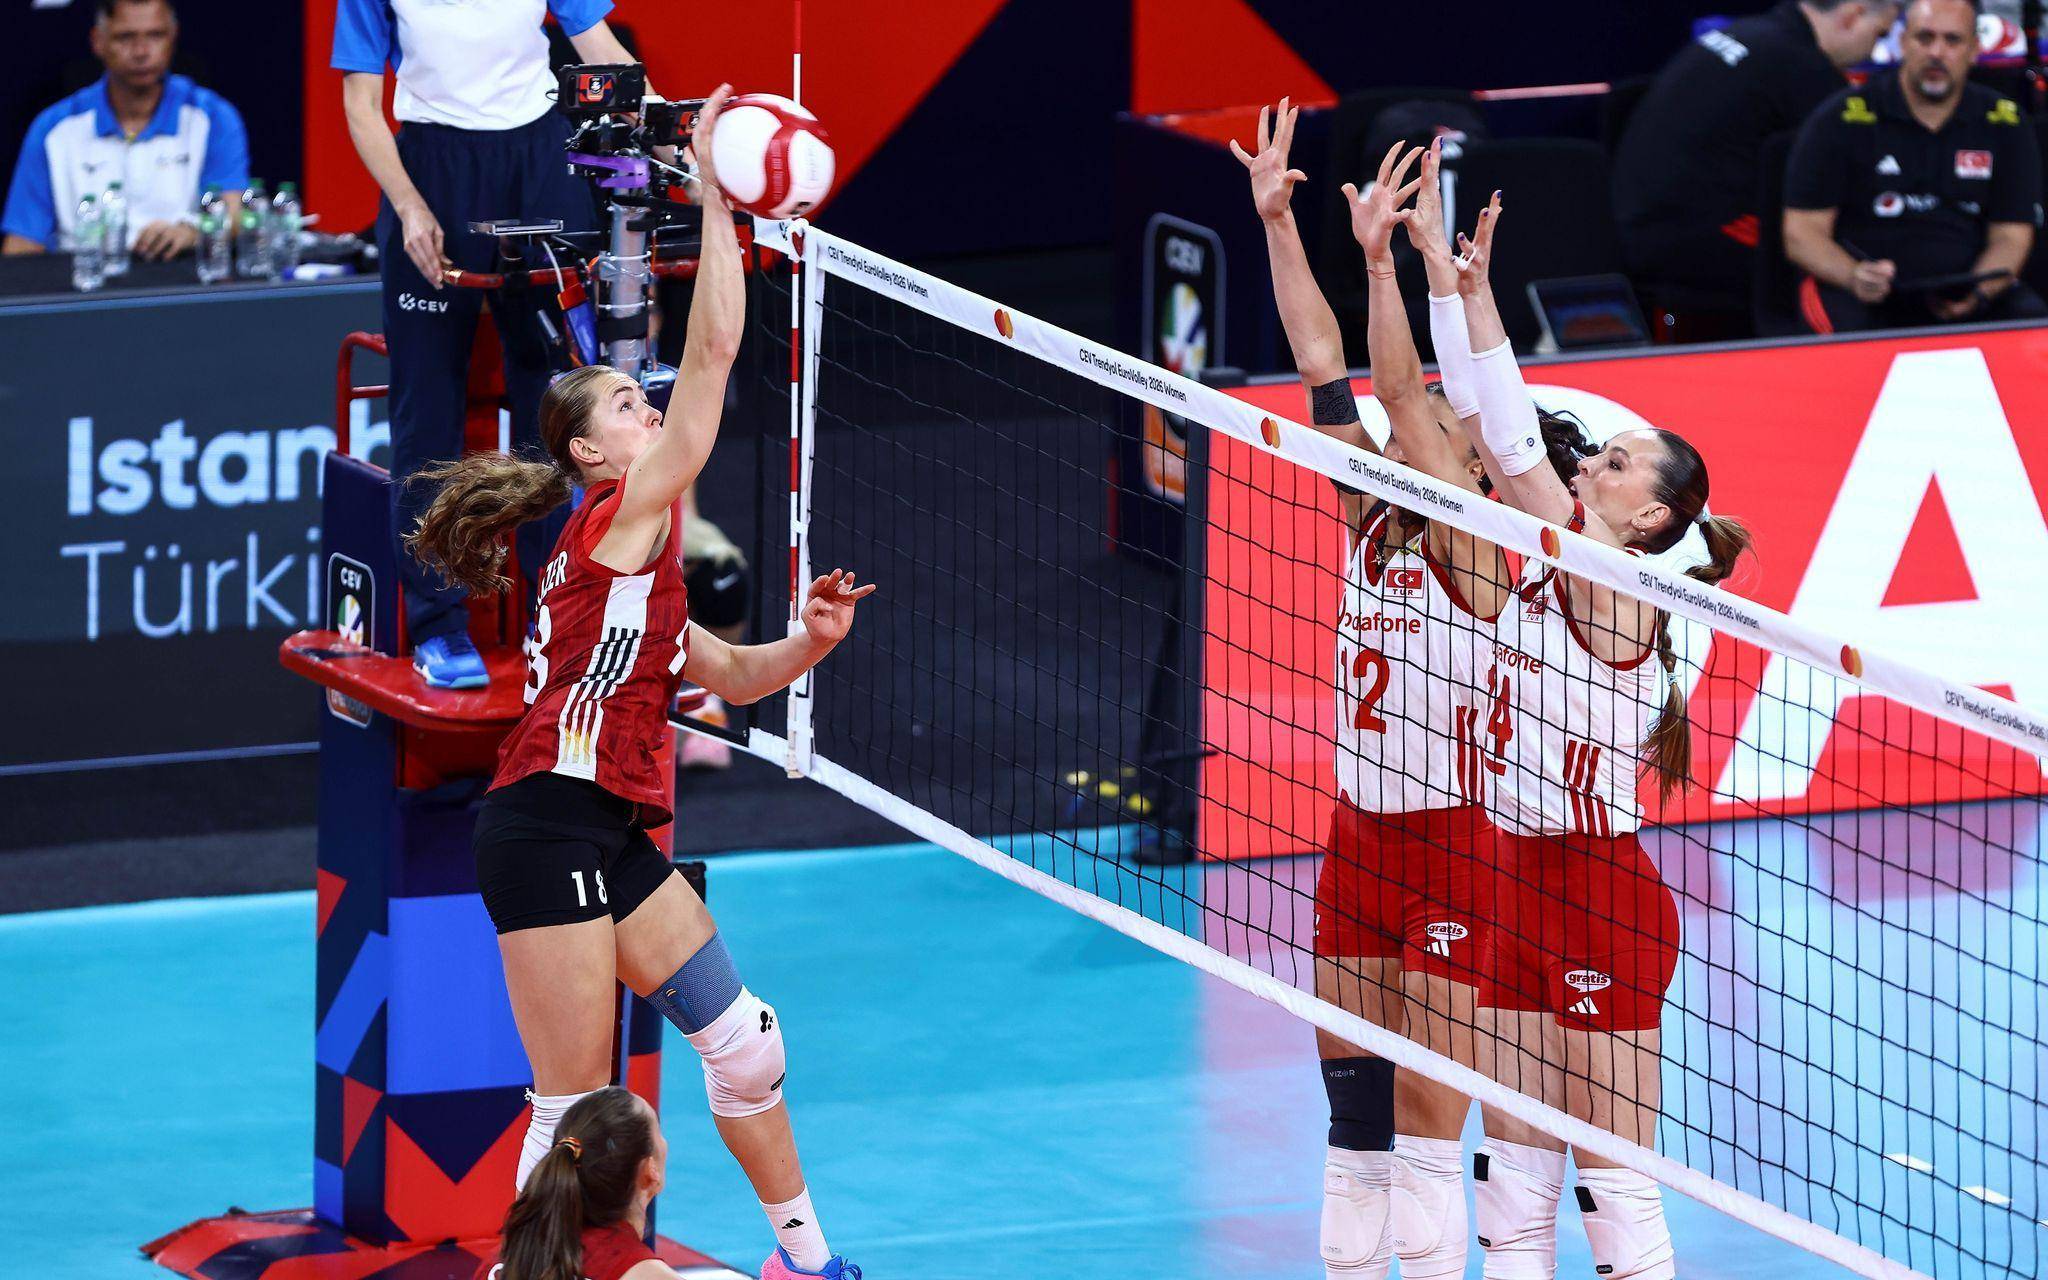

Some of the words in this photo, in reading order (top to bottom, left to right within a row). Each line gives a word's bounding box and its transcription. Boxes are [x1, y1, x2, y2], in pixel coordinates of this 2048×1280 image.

[828, 246, 839, 260] CEV
[840, 250, 863, 271] Trendyol
[864, 261, 893, 285] EuroVolley
[893, 272, 906, 289] 2026
[907, 278, 928, 298] Women
[417, 299, 448, 313] CEV
[1080, 348, 1092, 364] CEV
[1092, 353, 1118, 376] Trendyol
[1118, 364, 1148, 390] EuroVolley
[1148, 376, 1164, 393] 2026
[1164, 382, 1187, 402] Women
[1348, 458, 1362, 474] CEV
[1362, 463, 1390, 486] Trendyol
[1391, 473, 1422, 501] EuroVolley
[1422, 486, 1438, 505] 2026
[1438, 493, 1464, 514] Women
[59, 526, 320, 642] Türki
[340, 566, 363, 592] CEV
[1393, 588, 1413, 596] TUR
[1639, 571, 1653, 588] CEV
[1654, 576, 1683, 600] Trendyol
[1683, 588, 1717, 616] EuroVolley
[1717, 602, 1734, 620] 2026
[1734, 609, 1761, 630] Women
[1945, 690, 1960, 706] CEV
[571, 869, 608, 907] 18
[1429, 924, 1463, 936] gratis
[1569, 973, 1607, 985] gratis
